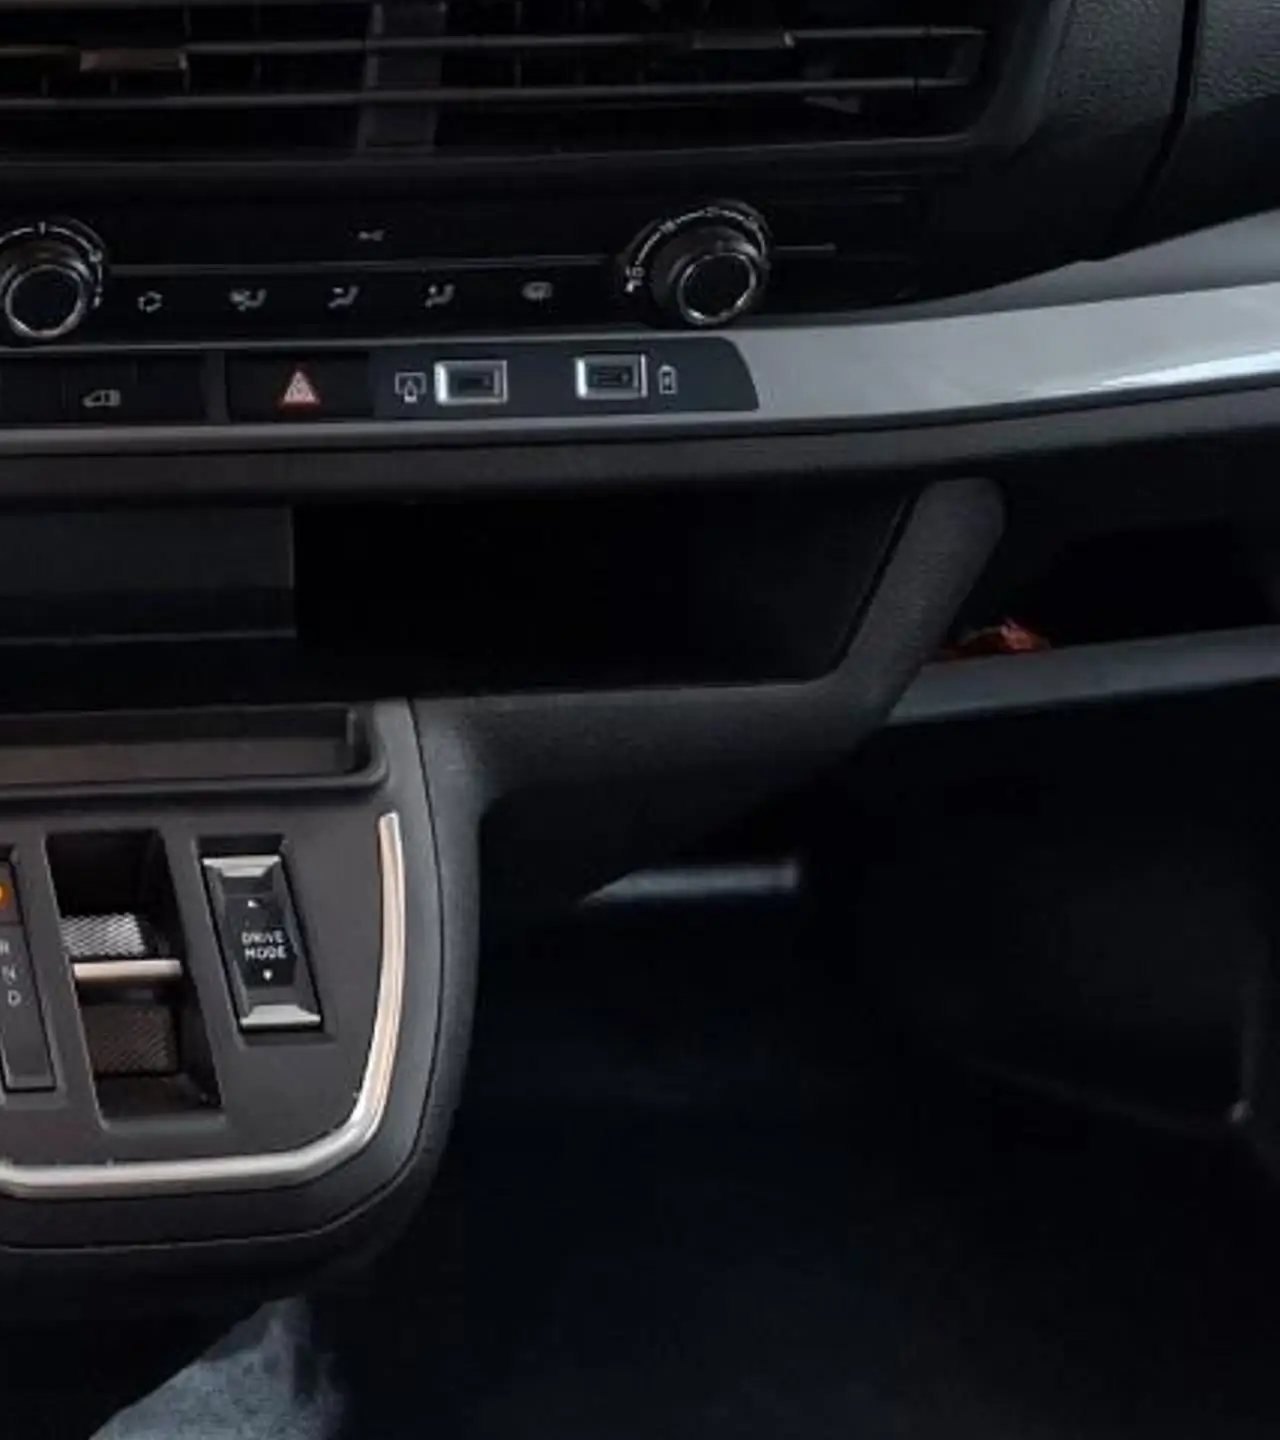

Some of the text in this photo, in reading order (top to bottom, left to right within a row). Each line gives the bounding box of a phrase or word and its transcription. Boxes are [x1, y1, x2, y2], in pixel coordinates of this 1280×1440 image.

[241, 930, 286, 946] DRIVE
[244, 945, 288, 960] MODE
[7, 989, 22, 1007] D
